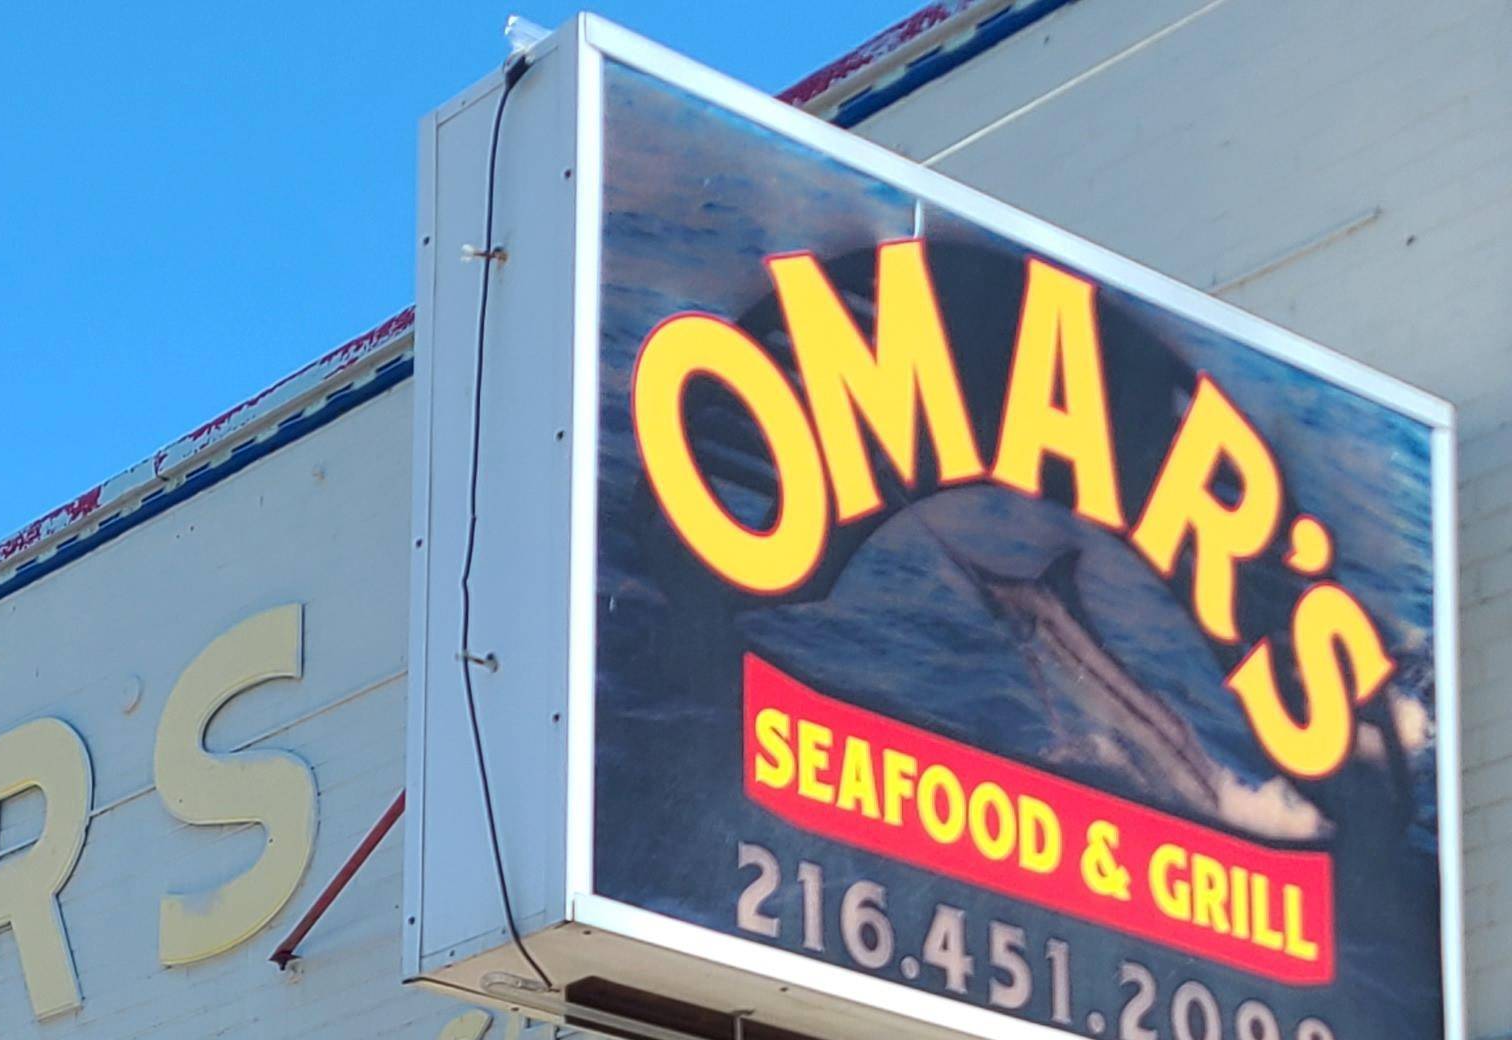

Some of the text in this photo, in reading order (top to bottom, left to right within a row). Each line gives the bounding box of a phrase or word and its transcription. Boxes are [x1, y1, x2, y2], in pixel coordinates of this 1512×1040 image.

[632, 237, 1396, 780] OMAR'S
[754, 707, 1320, 962] SEAFOOD & GRILL
